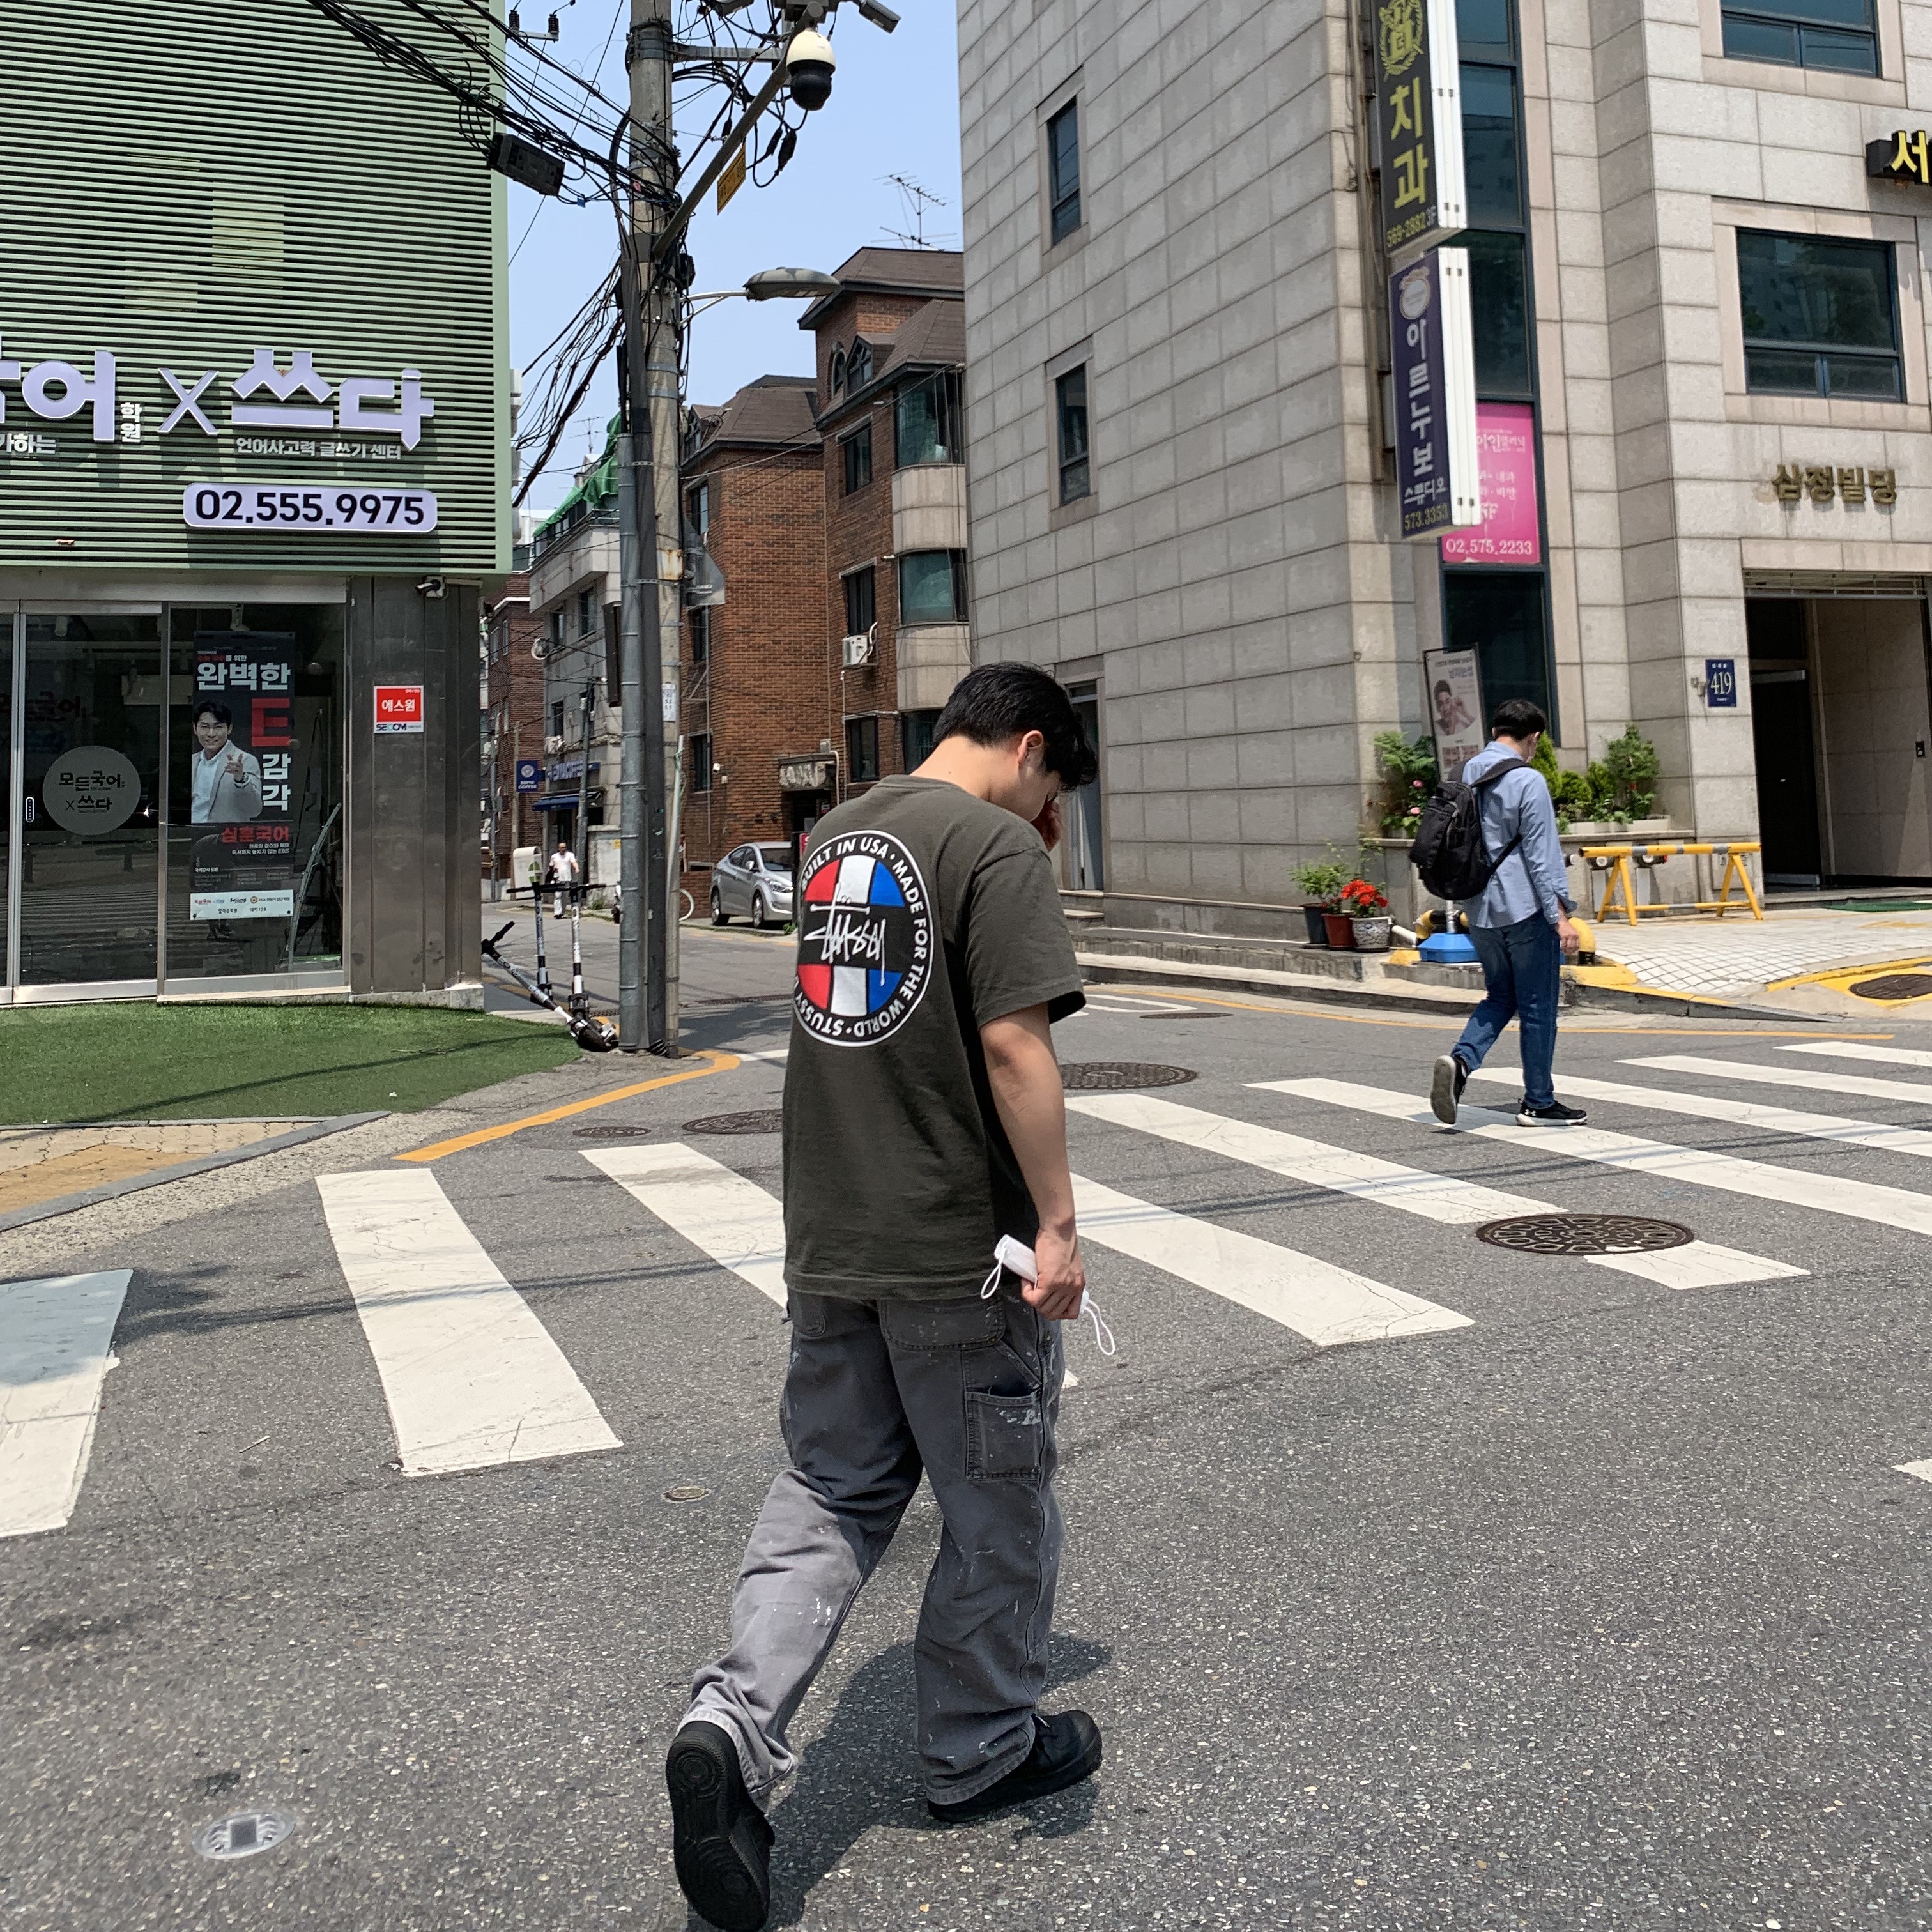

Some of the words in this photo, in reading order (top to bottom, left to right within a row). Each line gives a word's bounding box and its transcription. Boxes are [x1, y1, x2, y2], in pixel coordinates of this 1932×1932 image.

[1390, 76, 1429, 209] 치과
[0, 335, 116, 442] 어
[120, 402, 142, 443] 학원
[231, 348, 434, 452] 쓰다
[236, 437, 316, 456] 언어사고력
[320, 441, 366, 458] 글쓰기
[370, 444, 401, 460] 센터
[1772, 464, 1897, 503] 삼정빌딩
[195, 489, 425, 525] 02.555.9975
[1446, 539, 1533, 555] 02.575.2233
[197, 662, 291, 691] 완벽한
[1711, 671, 1732, 695] 419
[381, 698, 415, 712] 에스원
[59, 770, 121, 792] 모든국어
[263, 753, 291, 811] 감각
[77, 795, 112, 811] 쓰다
[801, 847, 832, 891] BUILT
[836, 837, 857, 856] IN
[860, 836, 889, 859] USA
[892, 858, 924, 914] MADE
[913, 917, 928, 959] FOR
[898, 963, 925, 1001] THE
[795, 992, 845, 1036] STUSSY
[854, 998, 905, 1038] WORLD
